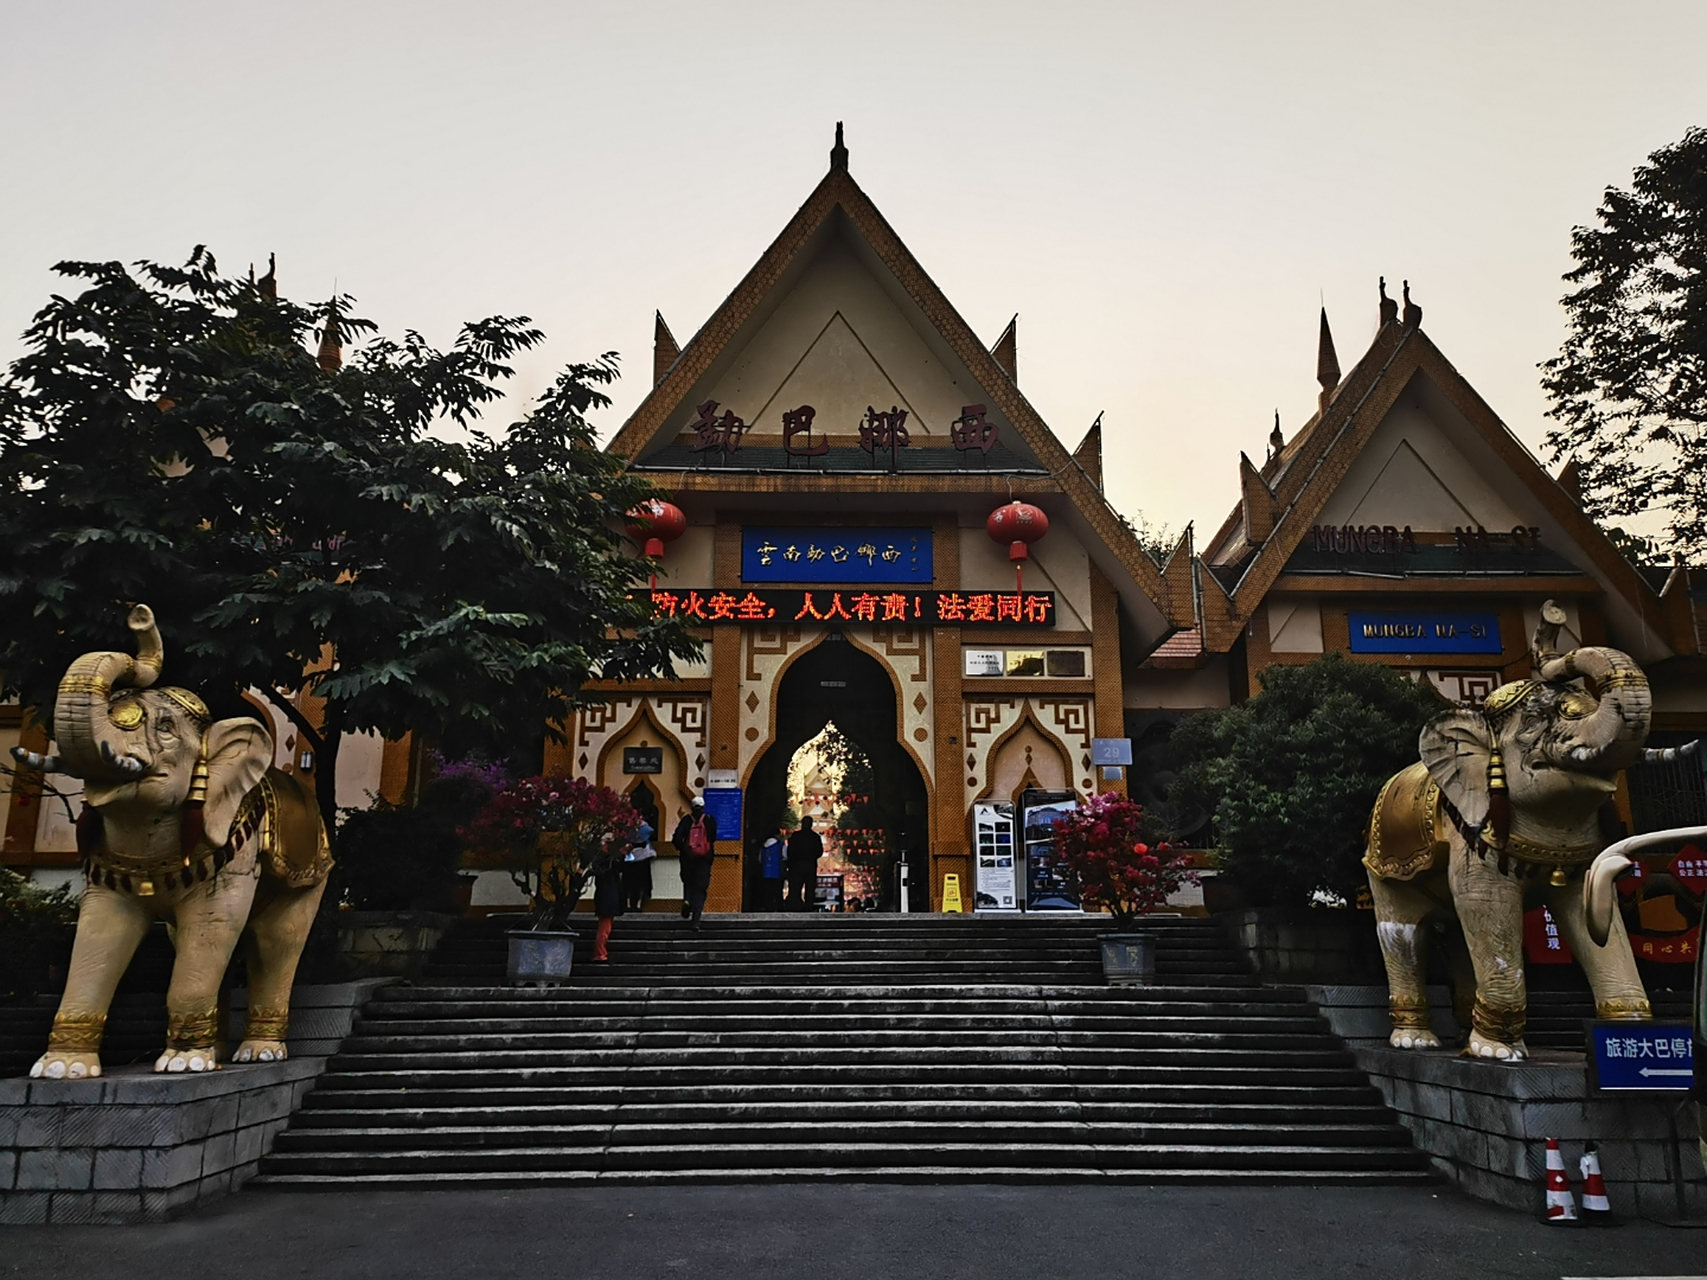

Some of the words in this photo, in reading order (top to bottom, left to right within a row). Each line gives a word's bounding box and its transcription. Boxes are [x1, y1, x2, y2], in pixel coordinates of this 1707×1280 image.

[691, 400, 1000, 460] 勐巴娜西
[1312, 525, 1418, 555] MUNGBA
[1363, 624, 1427, 639] MUNGBA
[1436, 624, 1488, 638] NA-SI
[1104, 747, 1120, 758] 29
